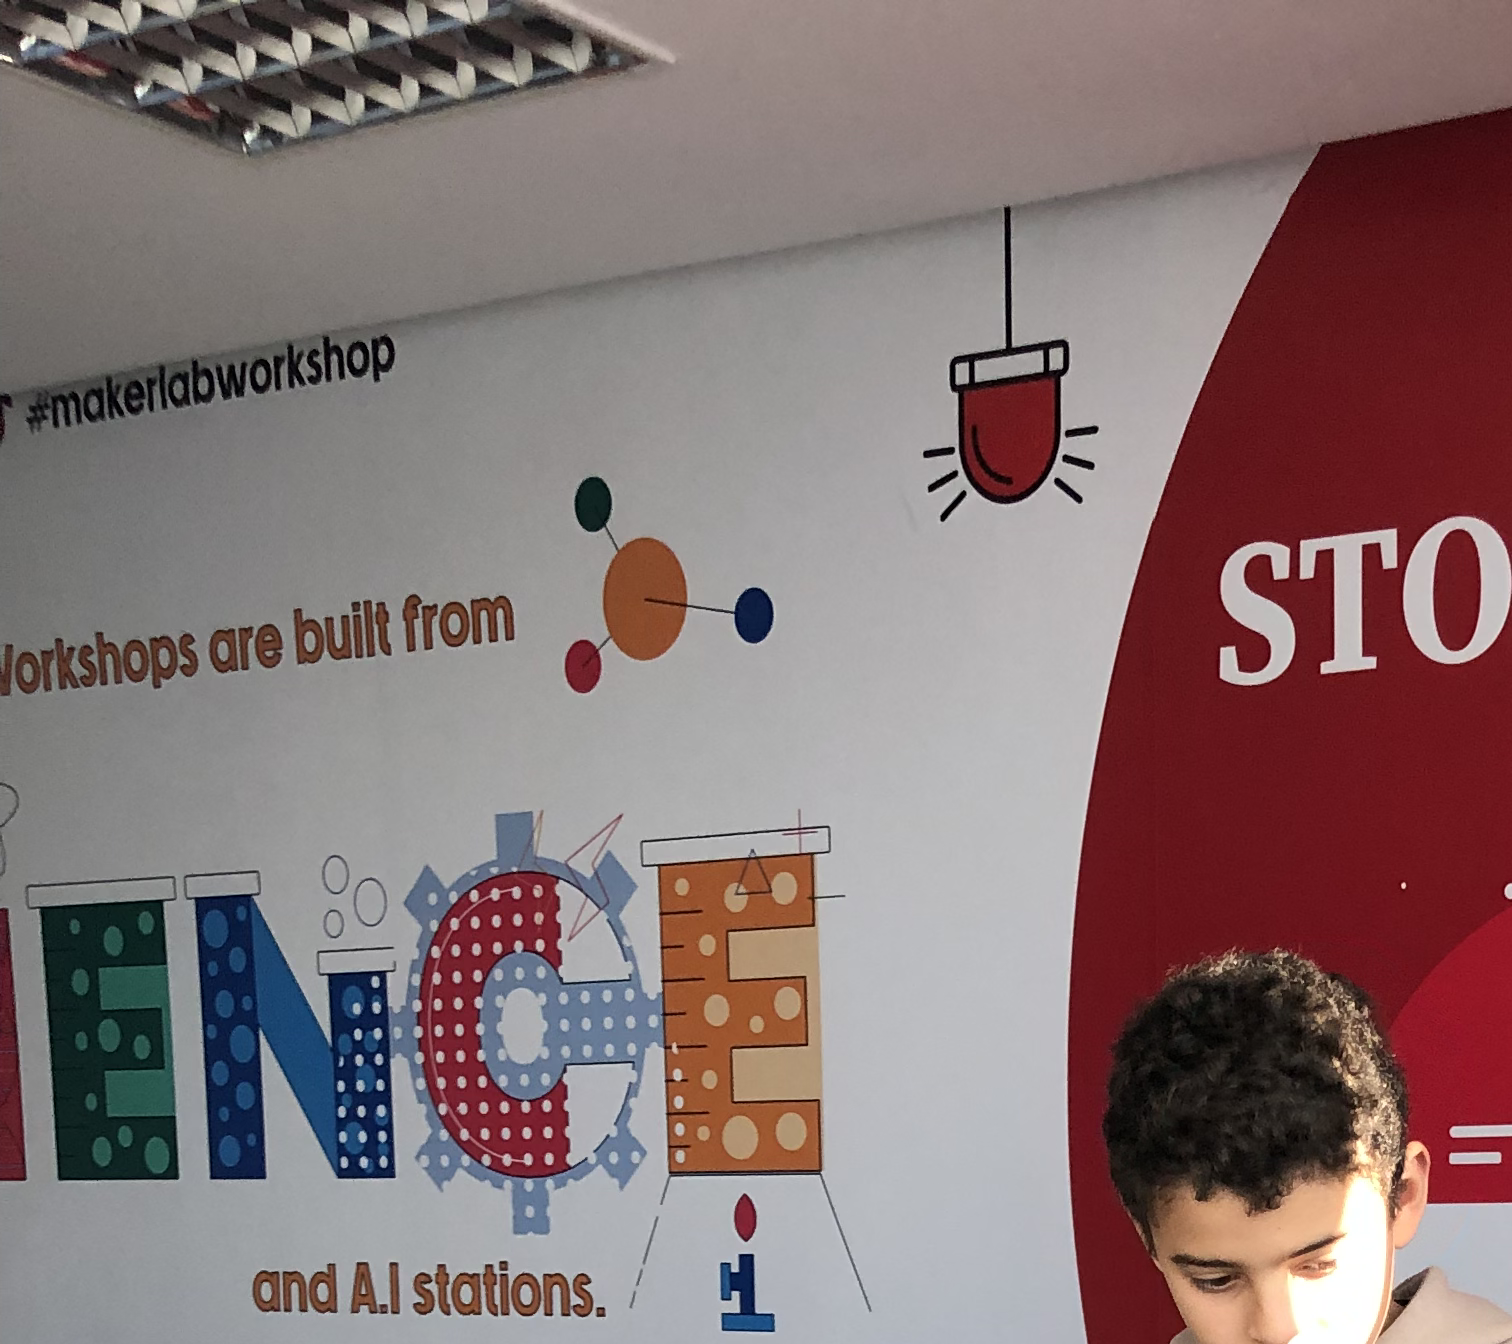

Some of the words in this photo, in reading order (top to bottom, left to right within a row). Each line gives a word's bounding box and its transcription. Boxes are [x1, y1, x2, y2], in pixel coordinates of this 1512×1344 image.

[25, 333, 396, 434] #makerlabworkshop
[210, 619, 284, 675] are
[293, 599, 391, 665] built
[402, 592, 517, 653] from
[252, 1262, 338, 1315] and
[412, 1261, 607, 1319] stations.
